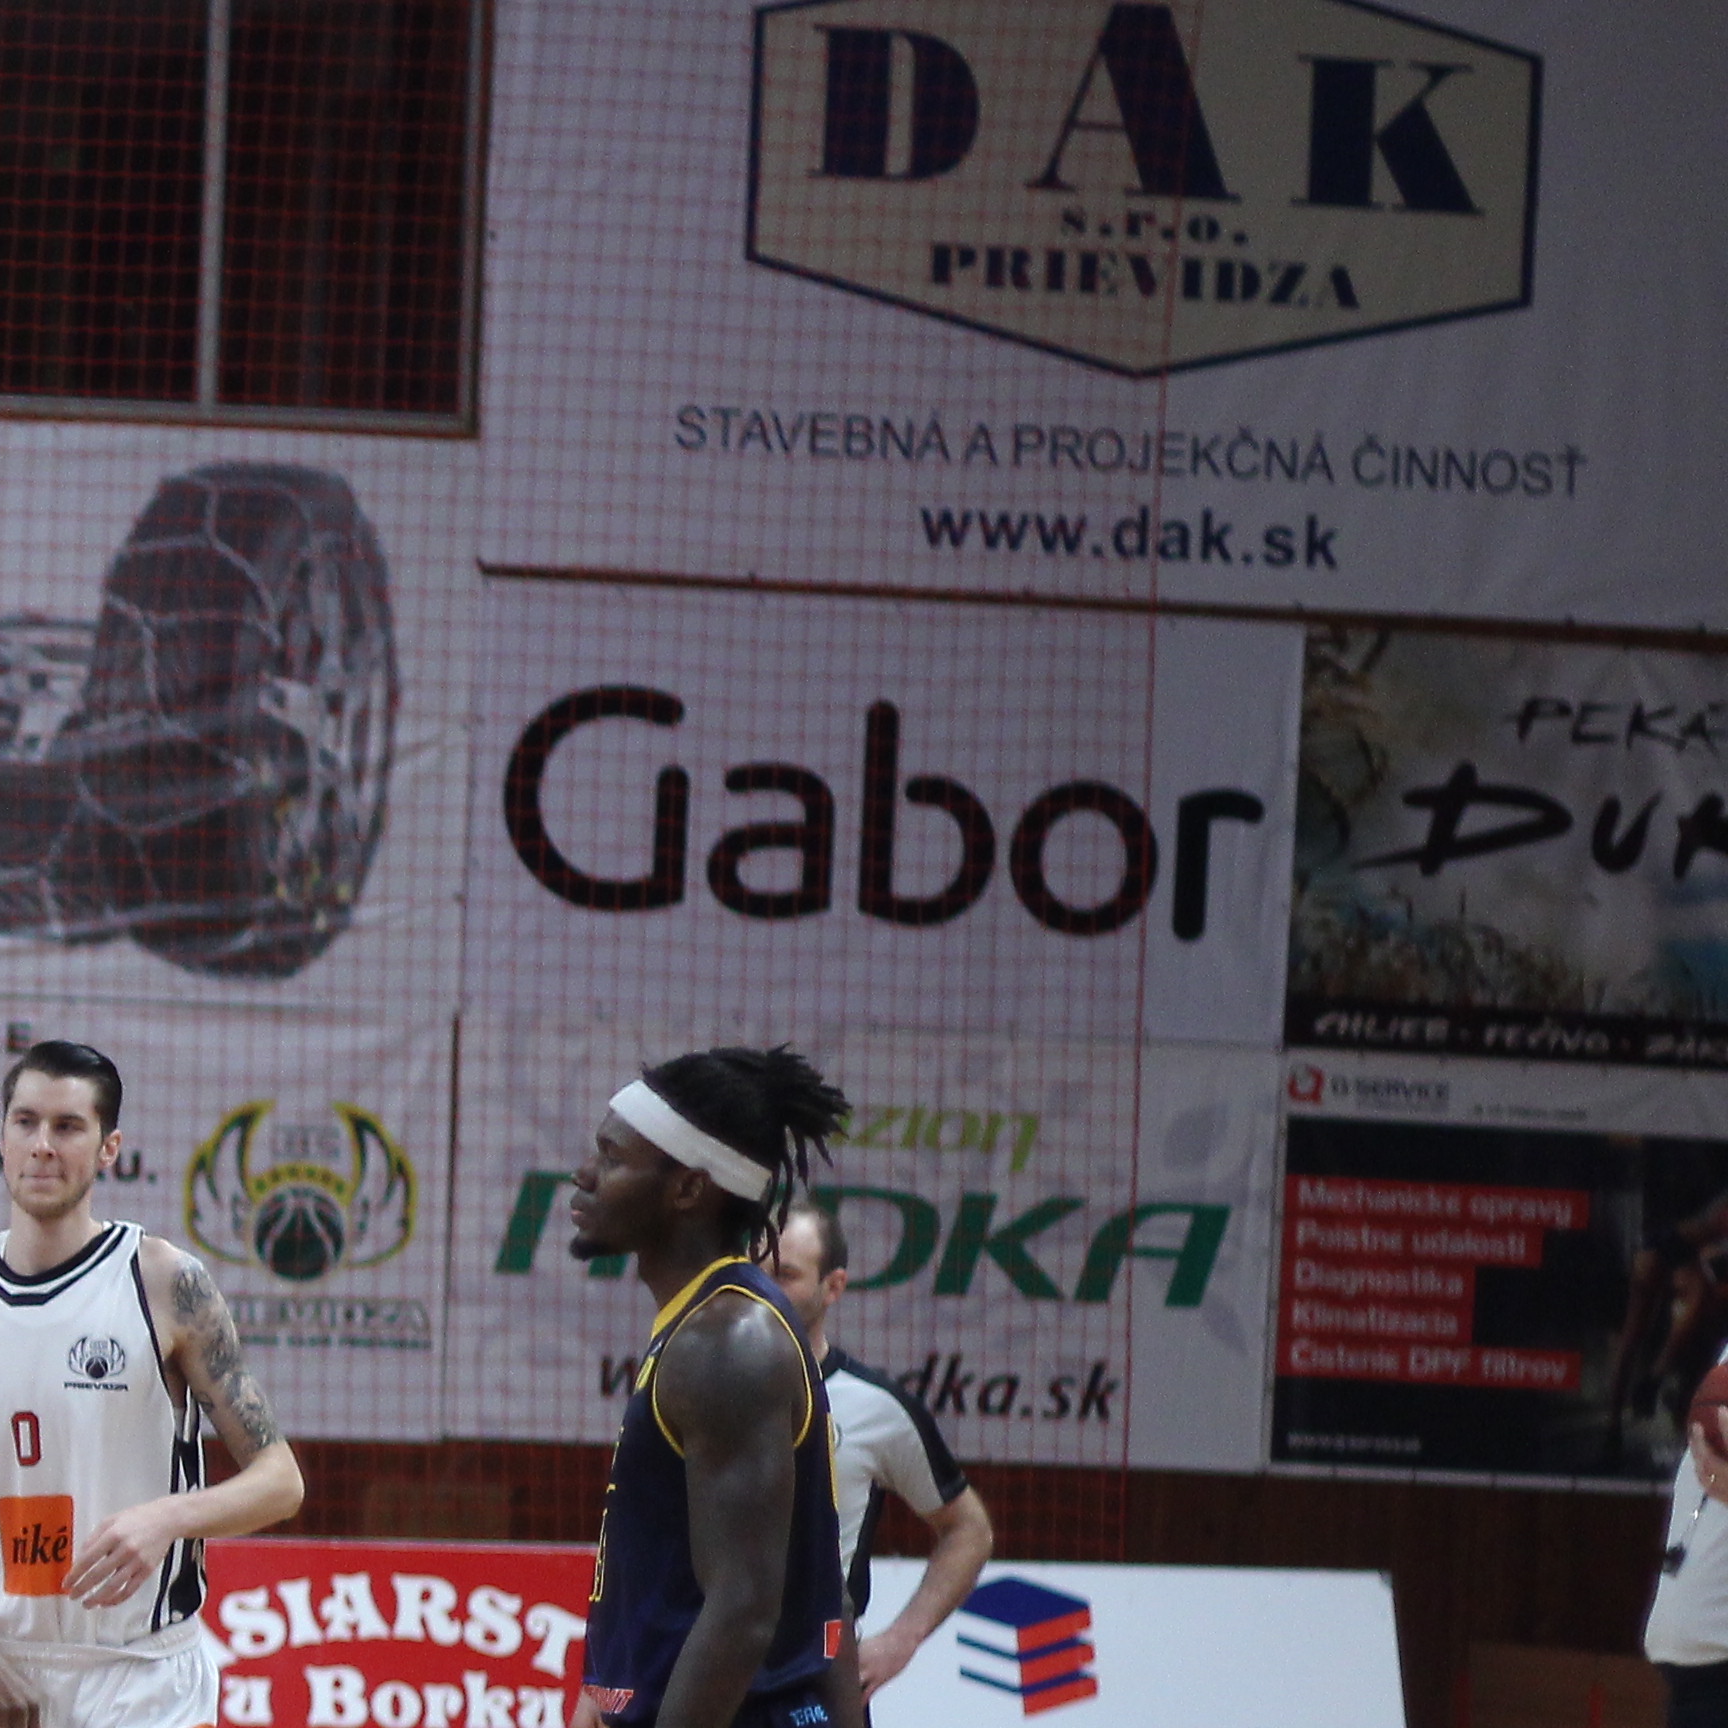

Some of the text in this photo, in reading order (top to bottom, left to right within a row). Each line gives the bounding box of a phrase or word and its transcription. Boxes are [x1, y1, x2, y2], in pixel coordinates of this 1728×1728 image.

[808, 0, 1483, 217] DAK
[1059, 207, 1249, 247] s.r.o.
[929, 244, 1360, 311] PRIEVIDZA
[673, 402, 1588, 499] STAVEBNÁ A PROJEKČNÁ ČINNOSŤ
[918, 502, 1340, 571] www.dak.sk
[501, 683, 1266, 943] Gabor
[1293, 1259, 1465, 1299] Diagnostika
